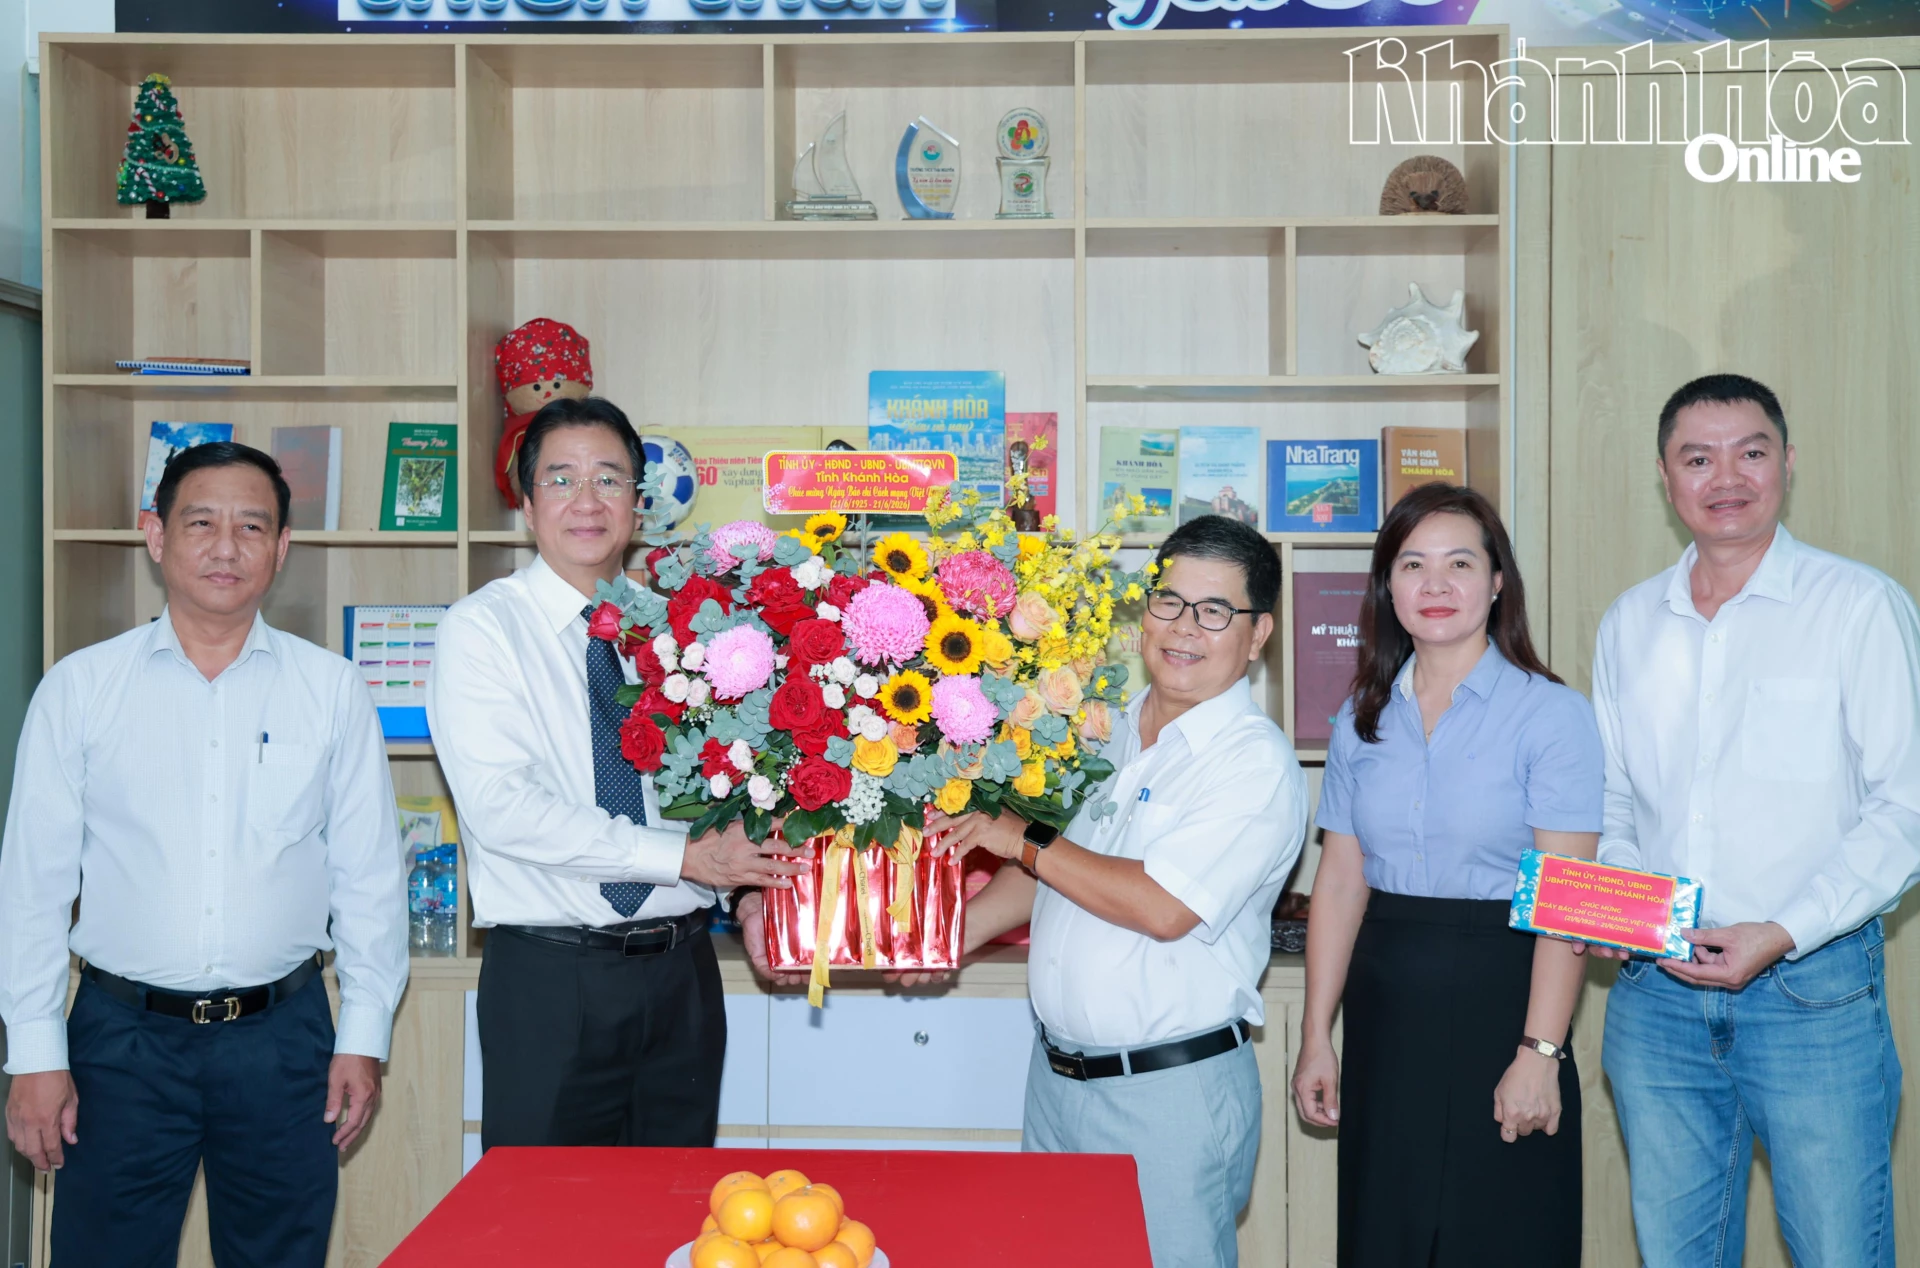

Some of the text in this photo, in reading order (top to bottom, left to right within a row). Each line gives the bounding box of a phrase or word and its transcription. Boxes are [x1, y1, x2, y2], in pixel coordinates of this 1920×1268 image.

[886, 394, 989, 420] KHÁNH HÒA
[1400, 448, 1418, 458] VĂN
[778, 455, 798, 470] TỈNH
[802, 455, 816, 470] ỦY
[824, 459, 852, 470] HĐND
[860, 460, 886, 470] UBND
[1400, 457, 1440, 468] DÂN GIAN
[696, 466, 718, 486] 60
[815, 470, 909, 484] Tỉnh Khánh Hòa
[1401, 466, 1456, 477] KHÁNH HÒA
[872, 500, 911, 510] 21/6/2026)
[1311, 623, 1360, 638] MỸ THUẬT
[1562, 867, 1582, 878] TỈNH
[1598, 875, 1626, 888] HĐND,
[1627, 880, 1653, 891] UBND
[1544, 875, 1666, 905] UBMTTQVN TỈNH KHÁNH HÒA
[1537, 901, 1558, 910] NGÀY
[1558, 904, 1574, 913] BÁO
[1580, 900, 1600, 910] CHÚC
